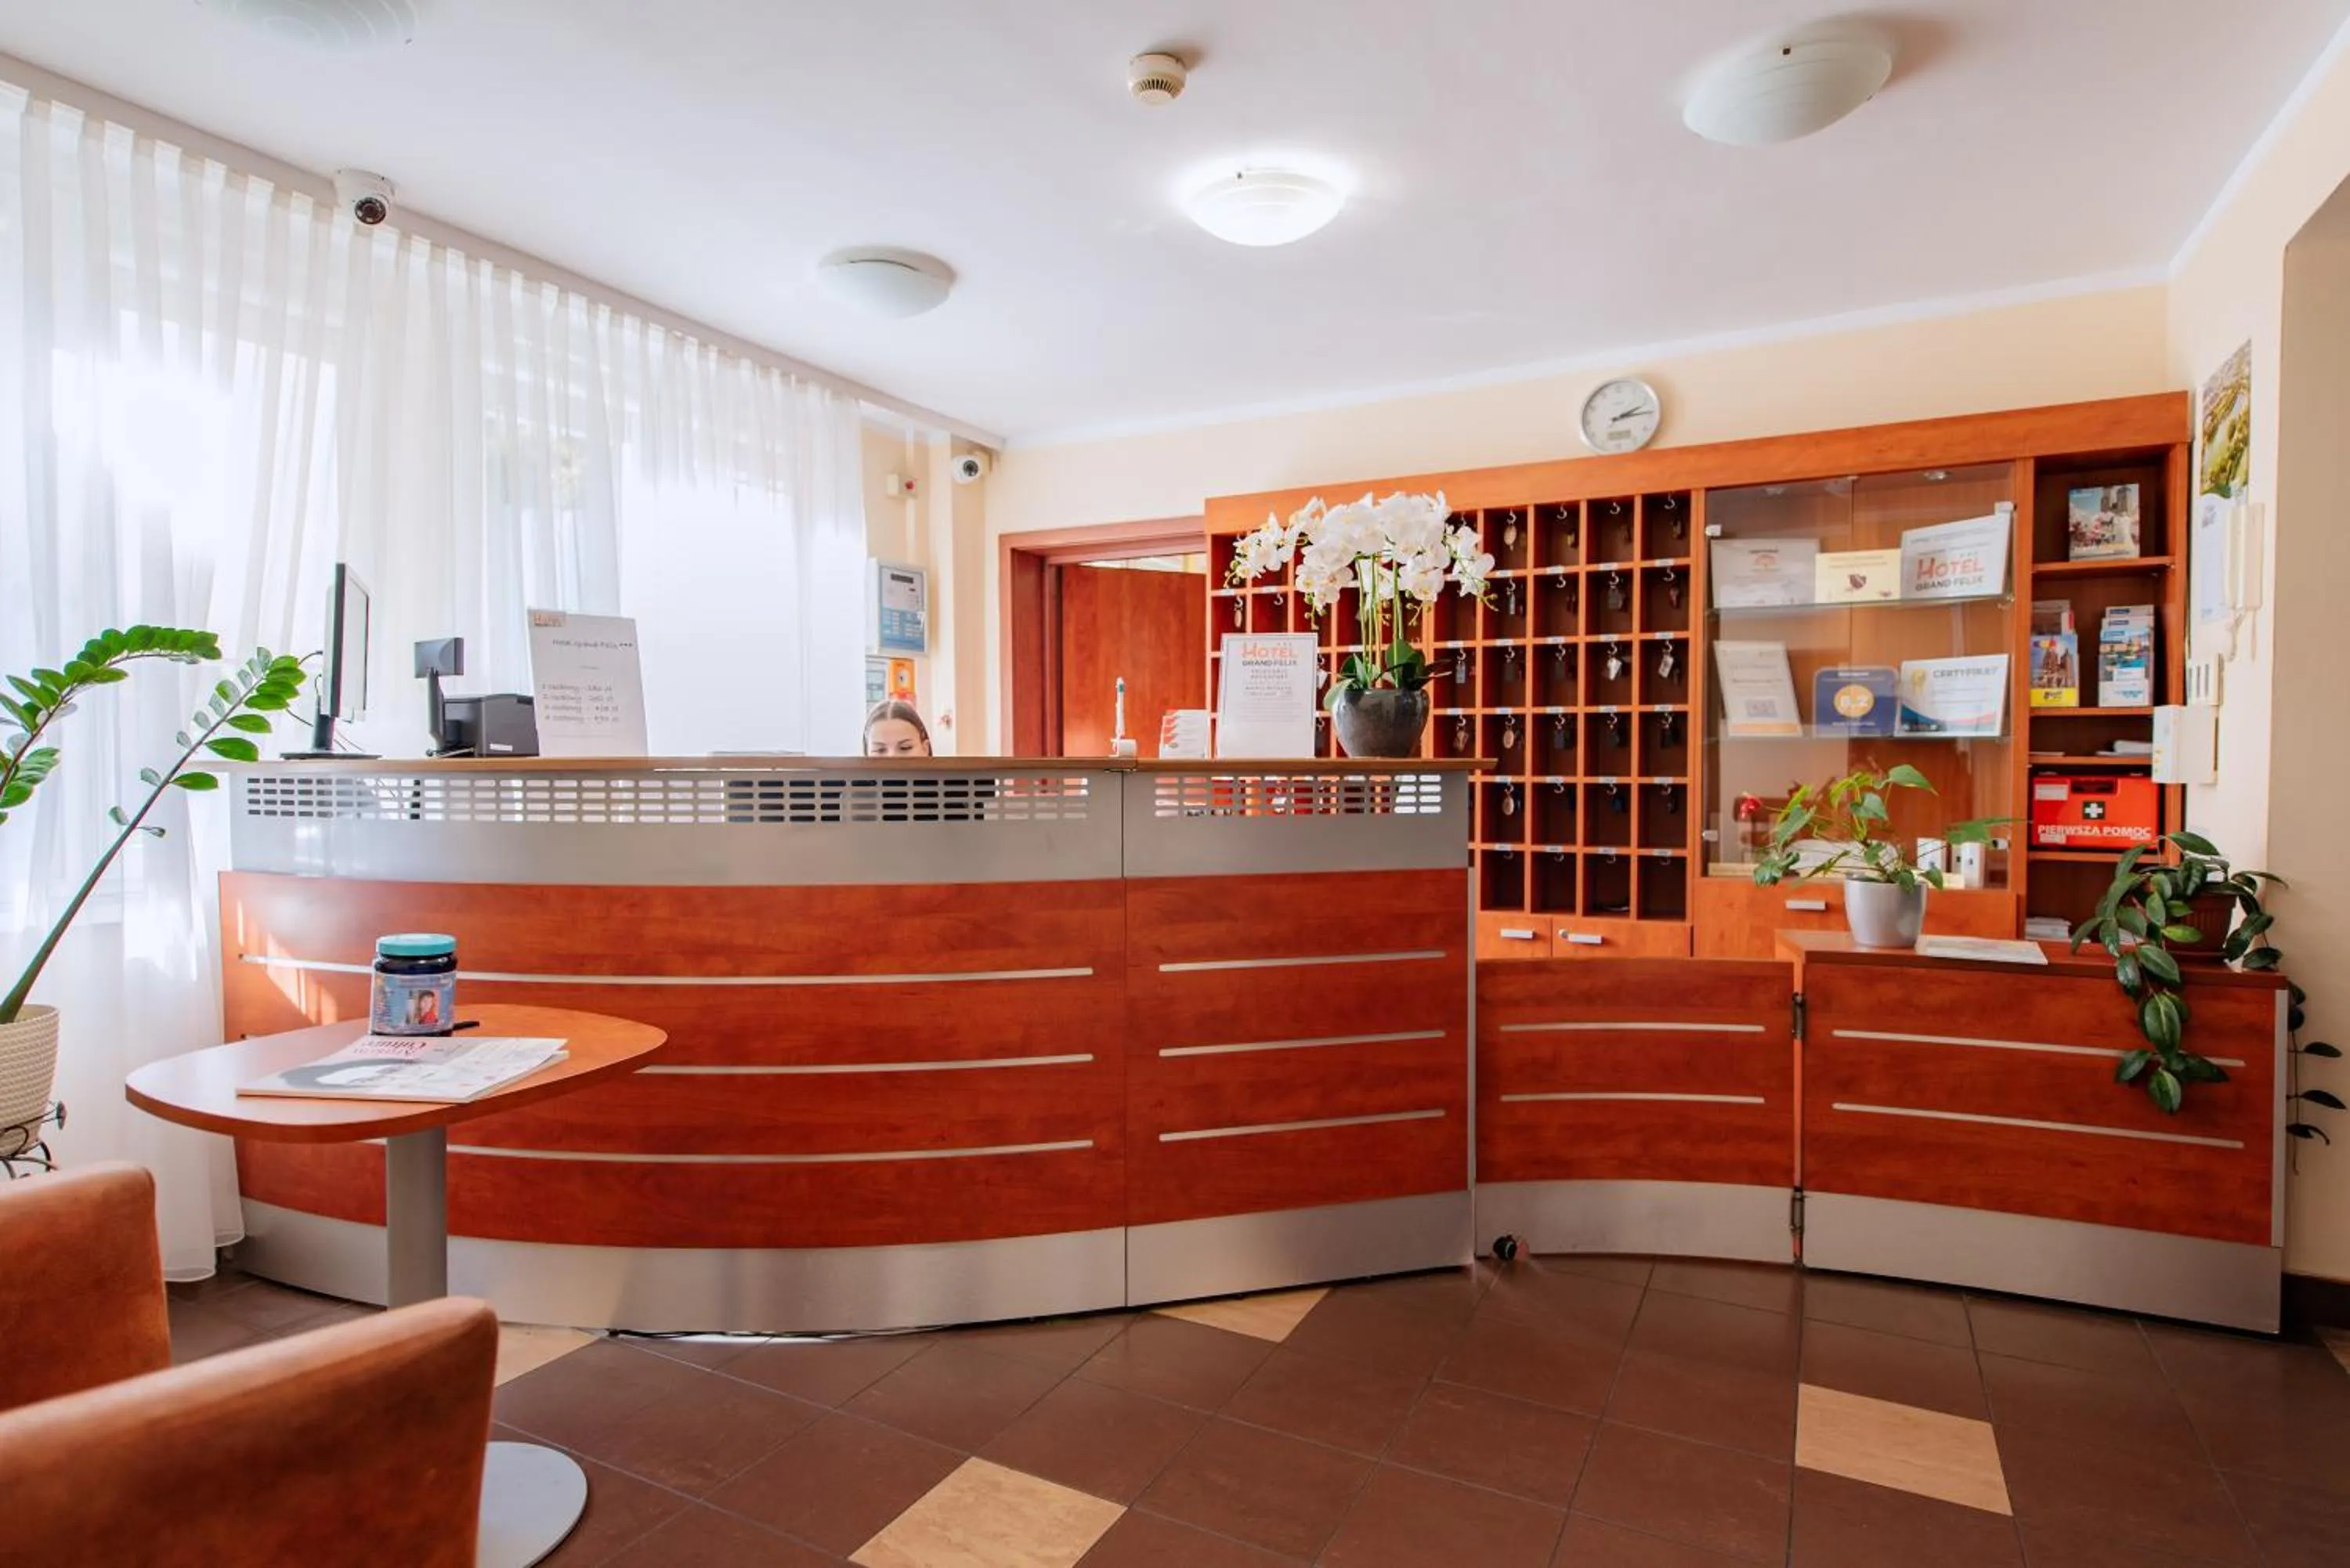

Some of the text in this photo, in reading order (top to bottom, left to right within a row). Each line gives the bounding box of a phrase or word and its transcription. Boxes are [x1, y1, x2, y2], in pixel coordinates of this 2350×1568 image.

[1917, 556, 1985, 580] HOTEL
[1915, 579, 1951, 591] GRAND
[1242, 642, 1298, 659] HOTEL
[2037, 824, 2153, 839] PIERWSZA POMOC
